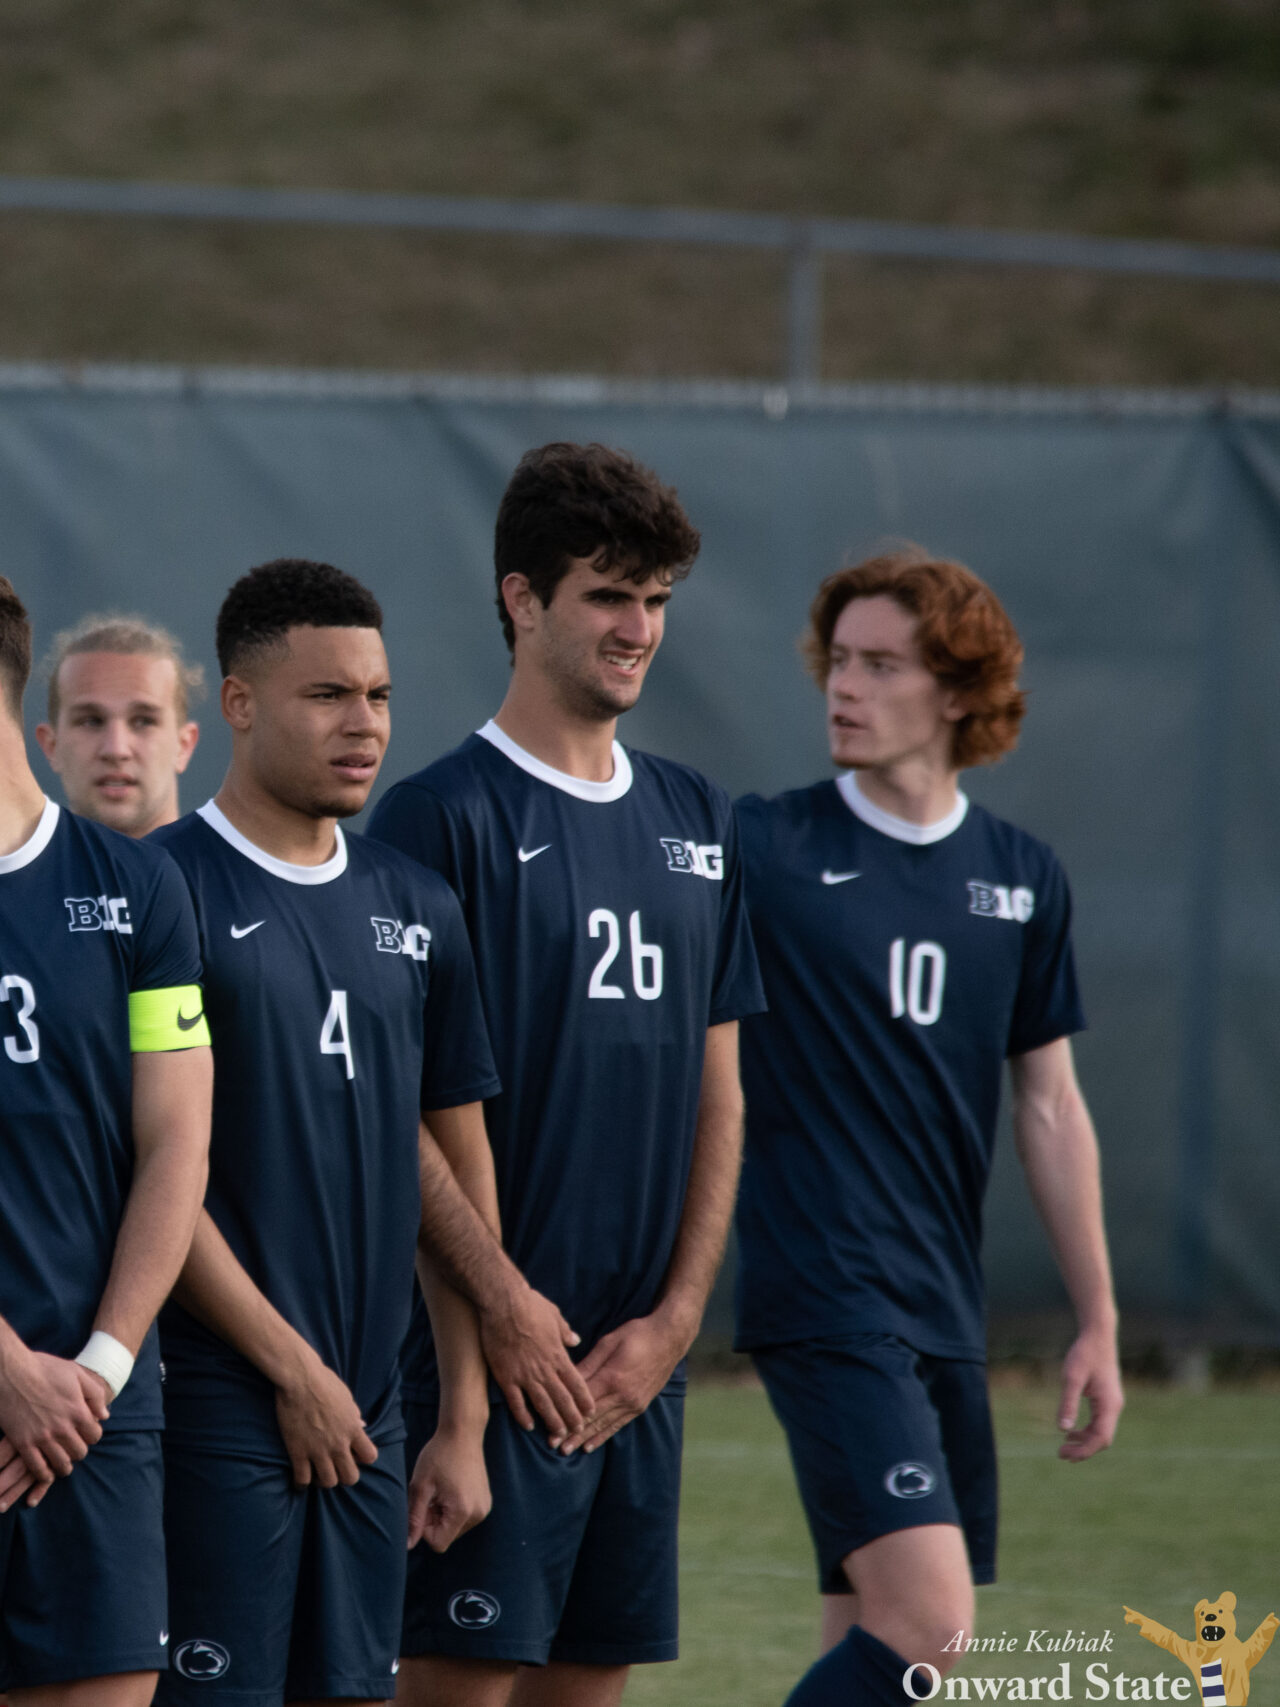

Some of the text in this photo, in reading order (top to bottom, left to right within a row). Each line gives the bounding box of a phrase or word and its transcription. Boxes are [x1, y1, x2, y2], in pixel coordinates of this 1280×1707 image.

[588, 908, 663, 1001] 26
[889, 938, 946, 1026] 10
[319, 989, 355, 1080] 4
